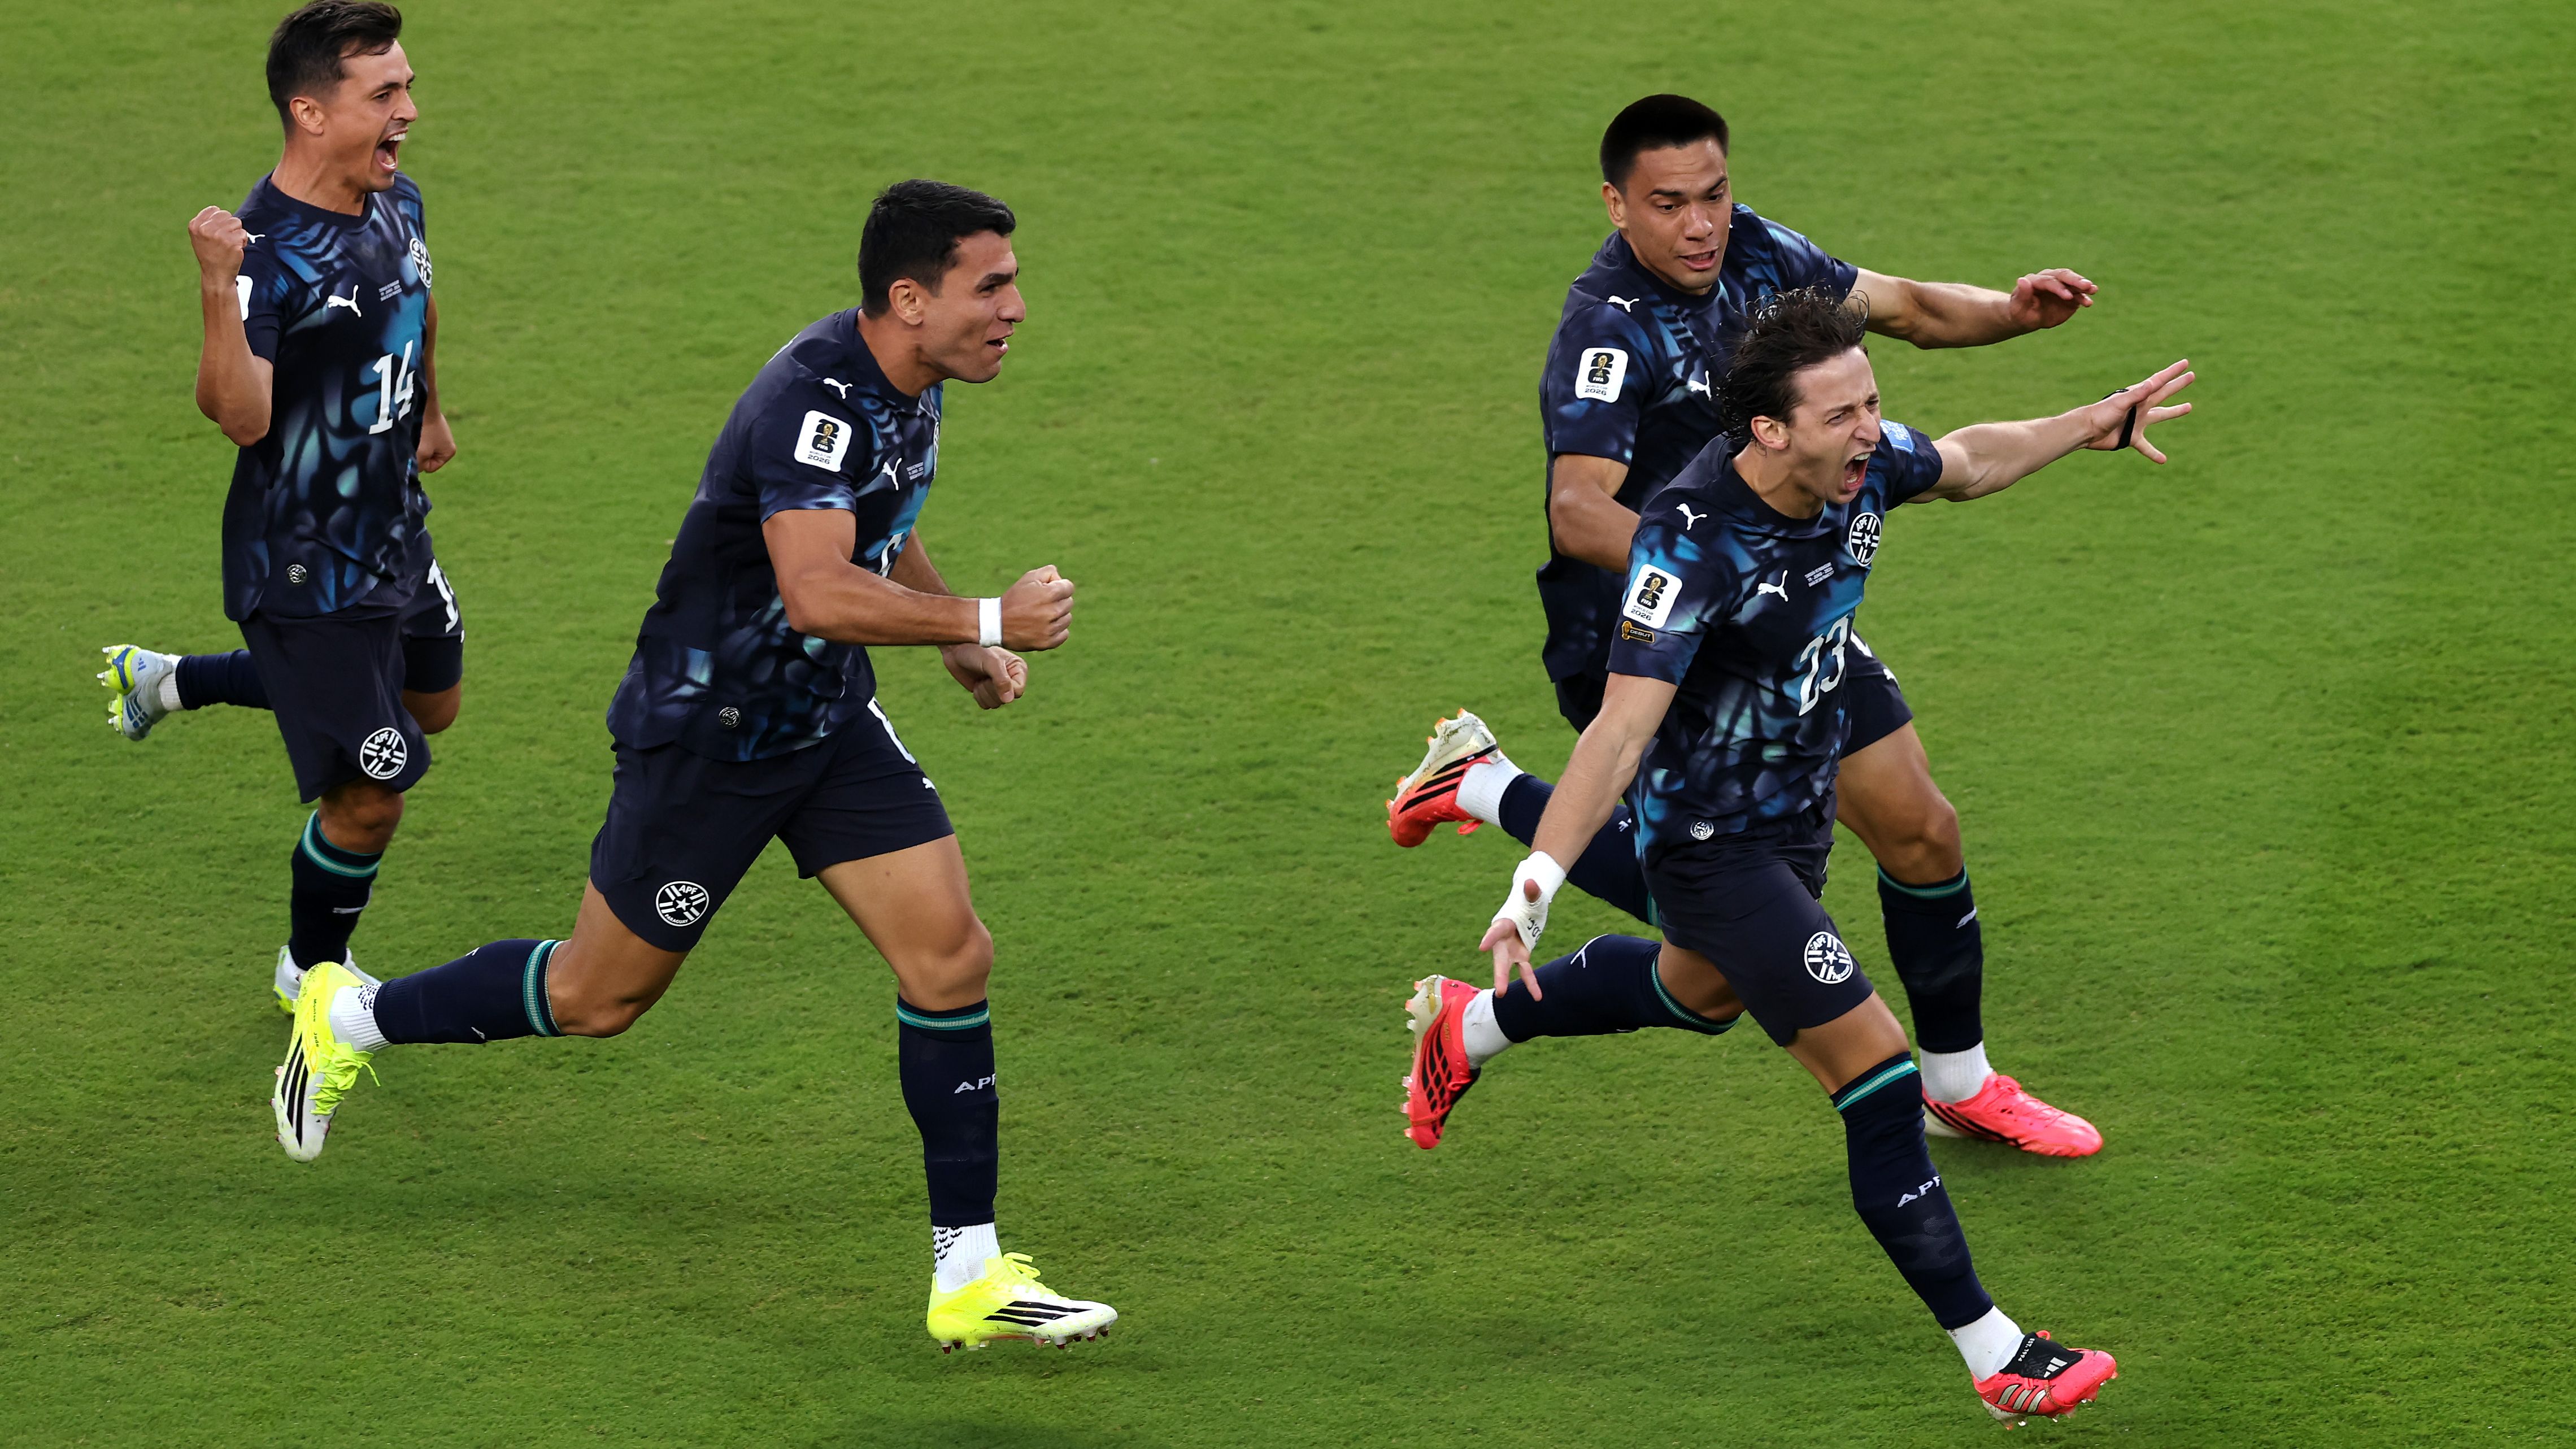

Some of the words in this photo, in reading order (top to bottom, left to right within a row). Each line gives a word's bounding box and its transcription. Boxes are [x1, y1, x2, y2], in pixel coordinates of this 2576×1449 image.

[369, 340, 415, 434] 14
[807, 454, 830, 464] 2026
[1856, 516, 1868, 532] APF
[427, 558, 459, 633] 1
[1630, 608, 1652, 621] 2026
[1630, 629, 1651, 638] DEBUT
[1799, 613, 1849, 716] 23
[678, 885, 698, 895] APF
[664, 913, 688, 924] PARAGUAY
